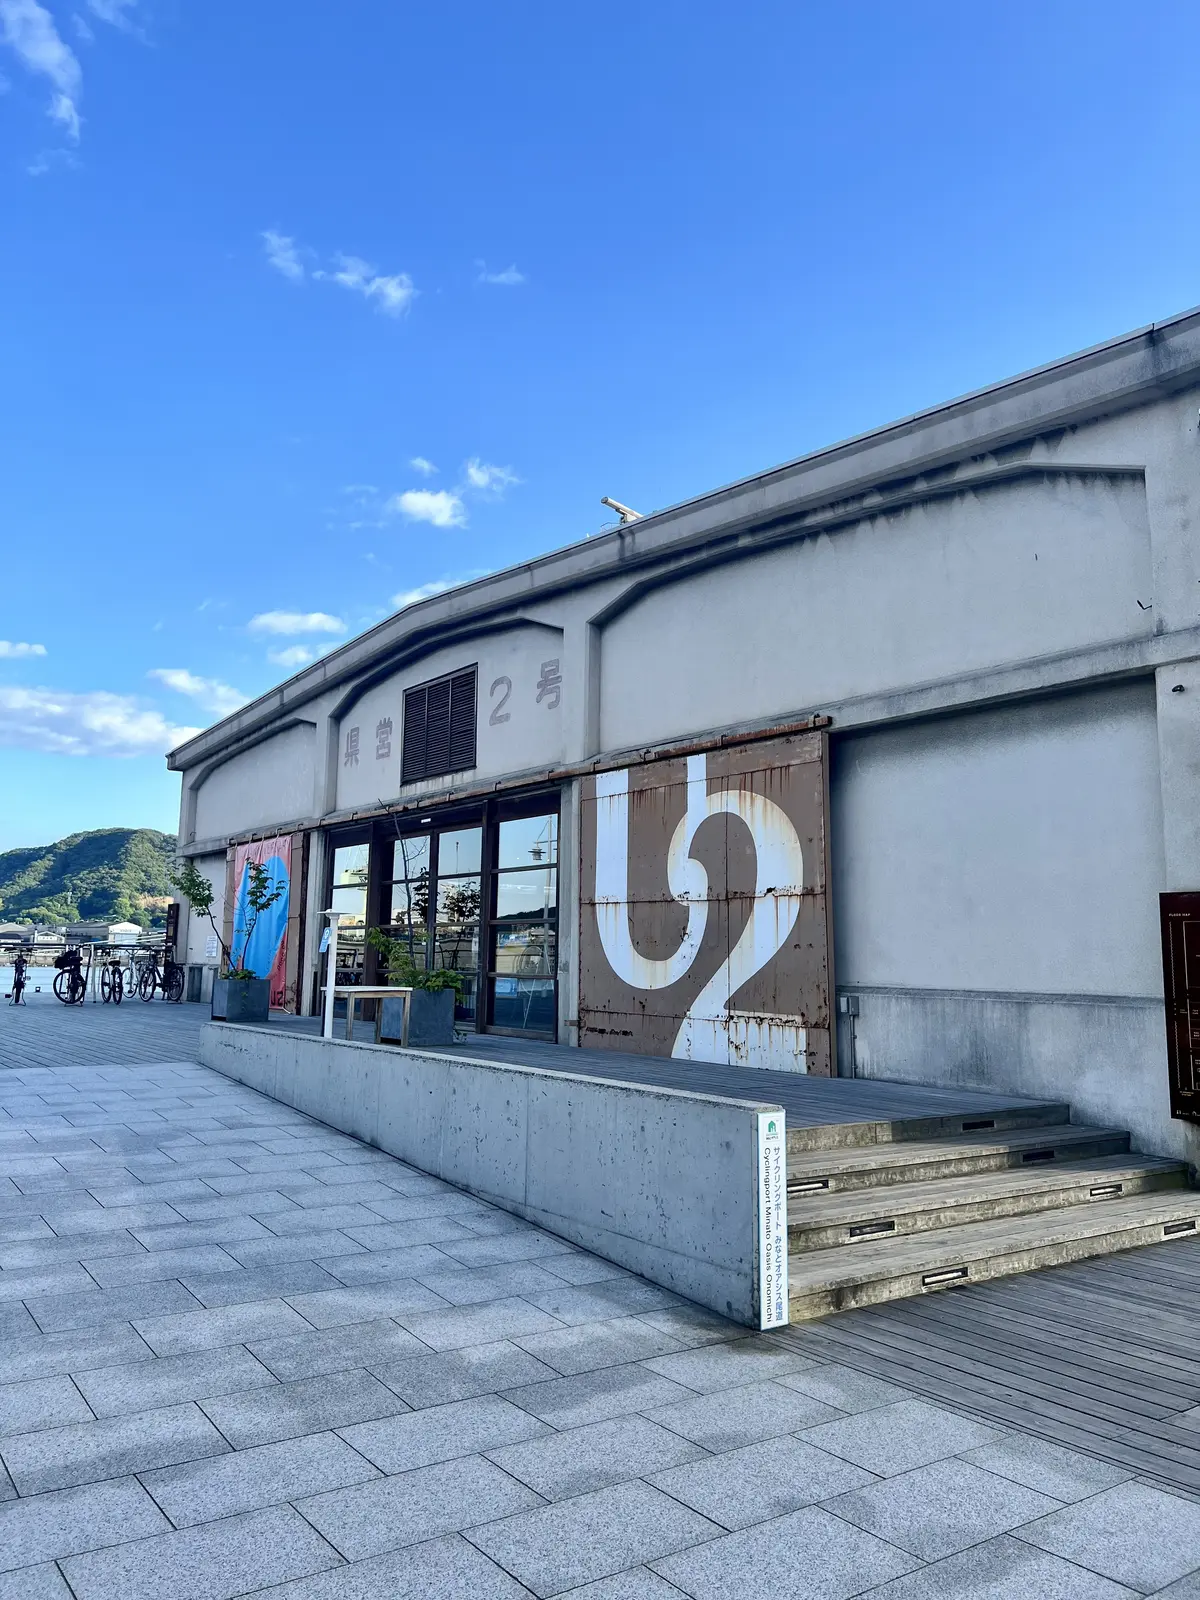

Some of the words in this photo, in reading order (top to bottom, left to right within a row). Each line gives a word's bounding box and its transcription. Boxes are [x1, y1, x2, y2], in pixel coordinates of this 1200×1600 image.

[344, 716, 393, 768] 県営
[489, 658, 563, 727] 2号
[595, 753, 808, 1075] U2
[763, 1147, 772, 1203] Cyclingport
[765, 1242, 773, 1271] Oasis
[774, 1235, 783, 1321] みなとオアシス尾道
